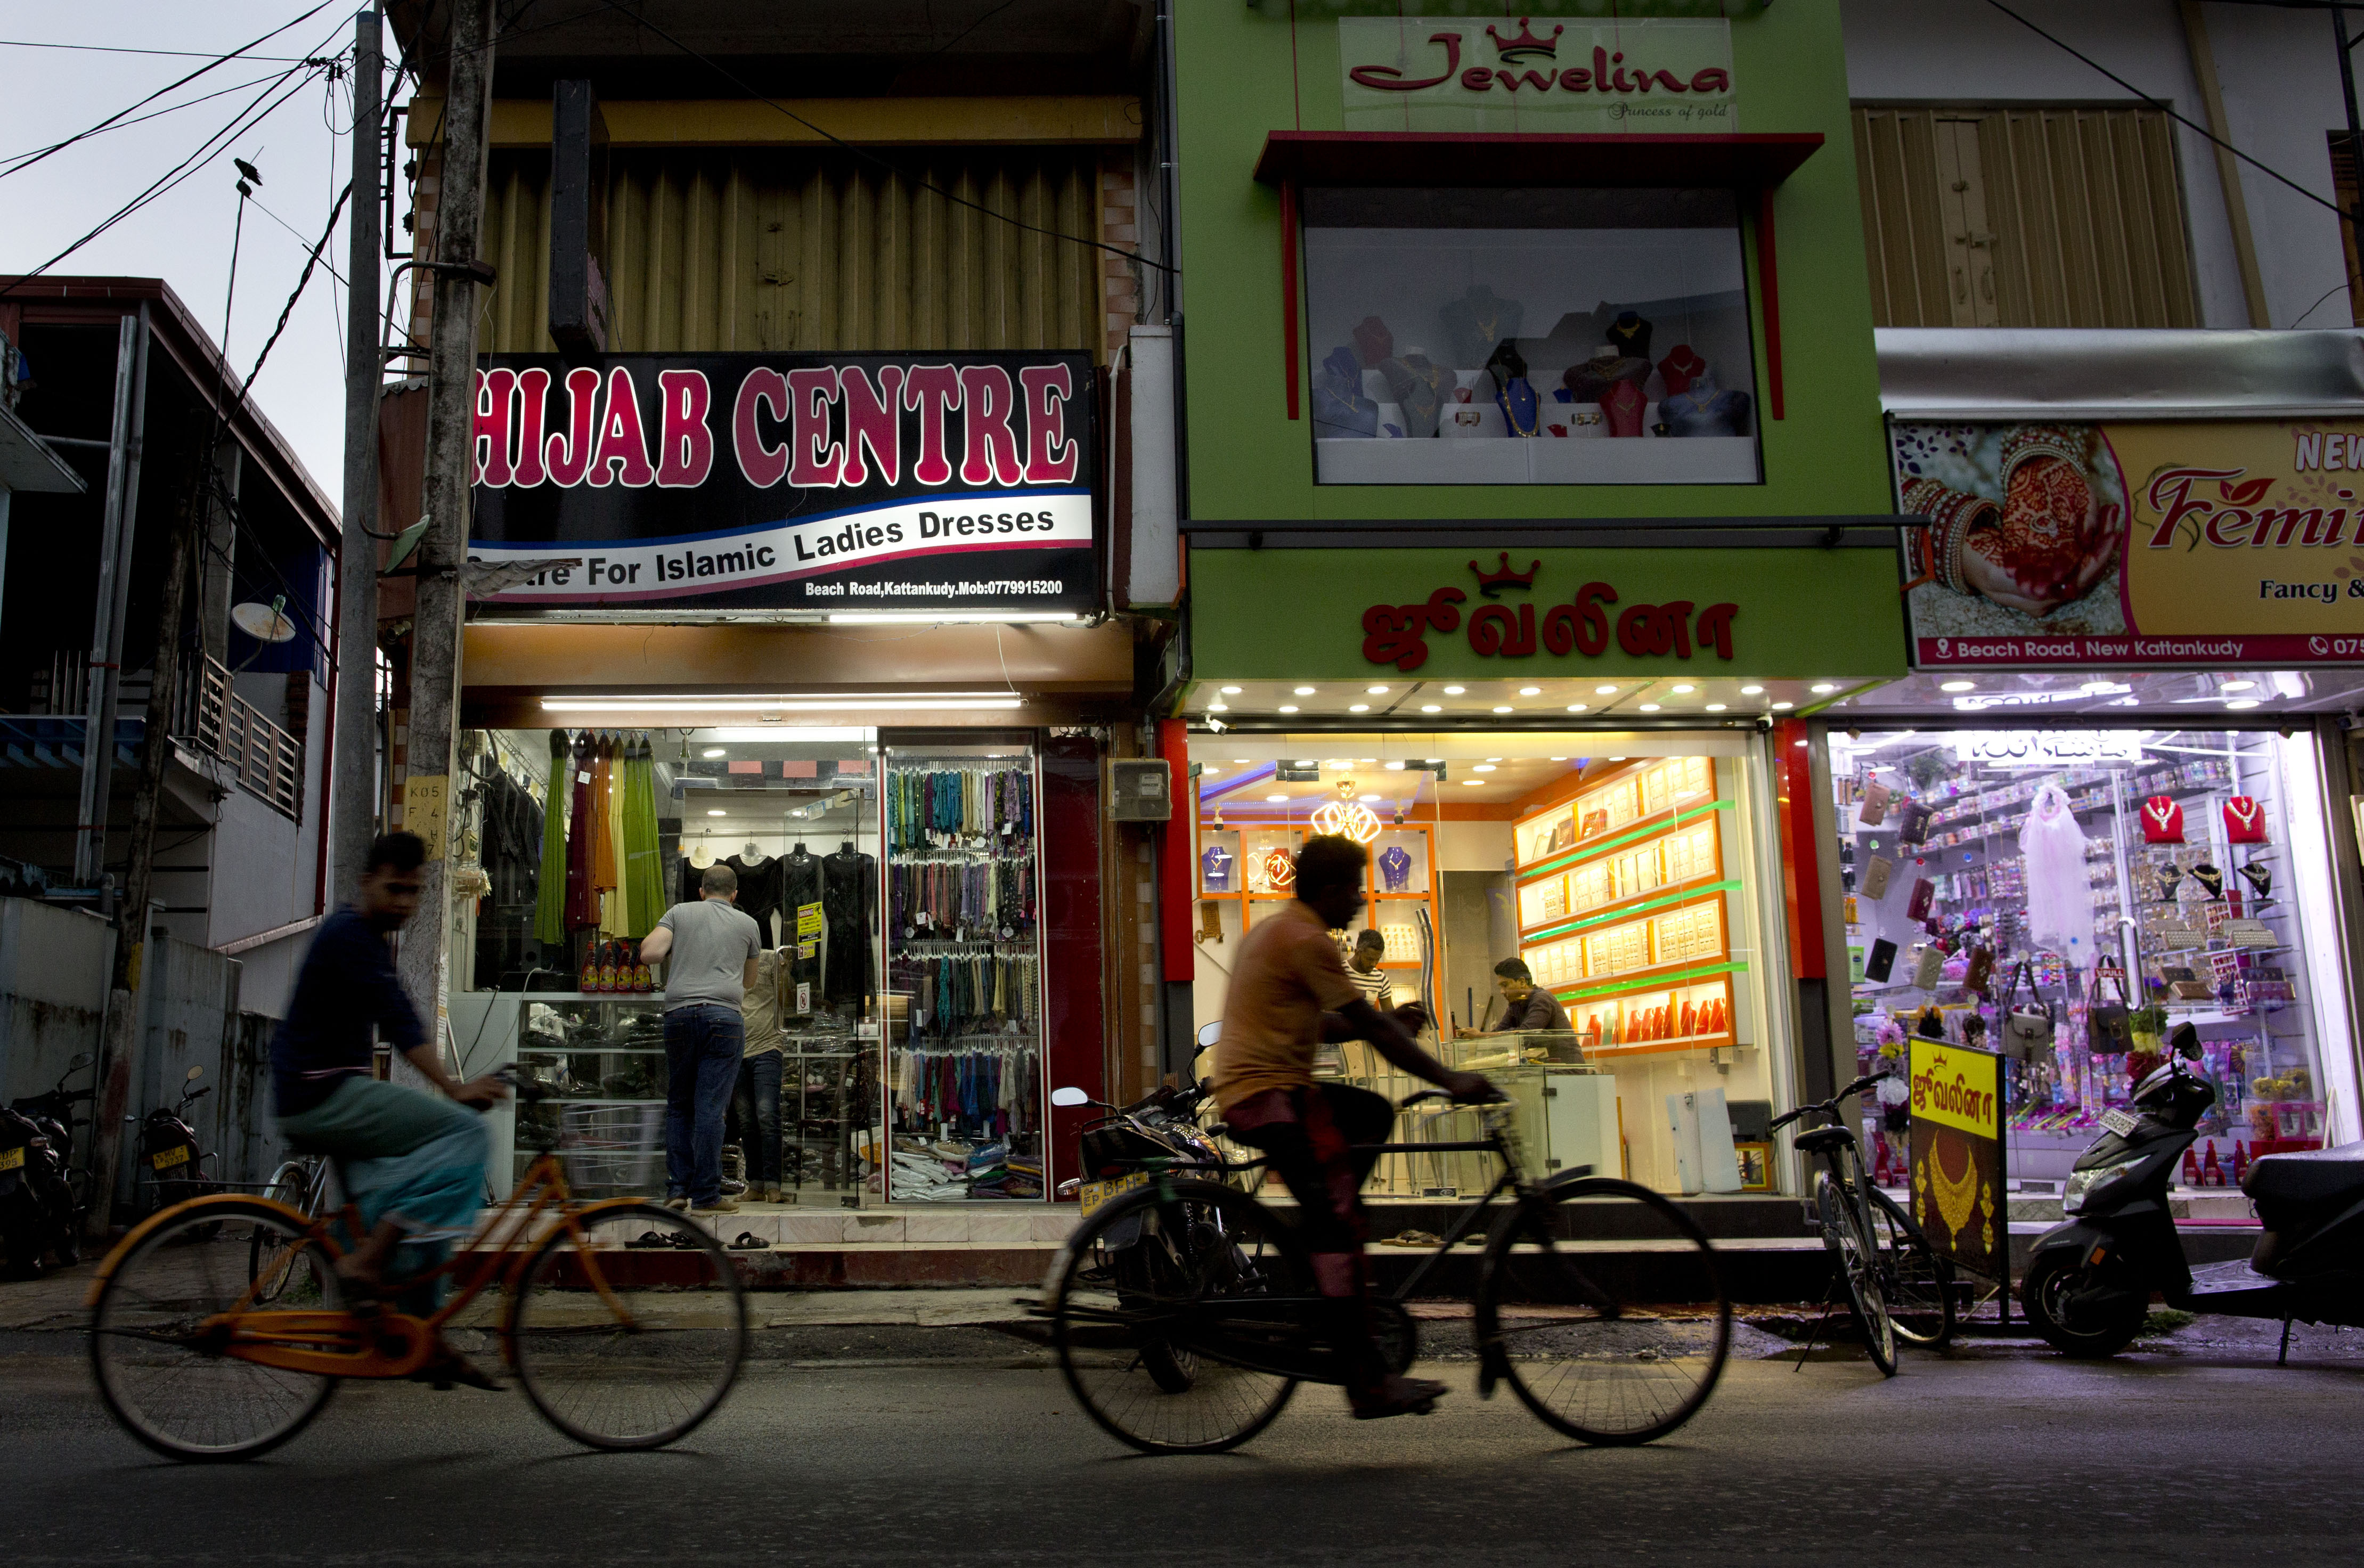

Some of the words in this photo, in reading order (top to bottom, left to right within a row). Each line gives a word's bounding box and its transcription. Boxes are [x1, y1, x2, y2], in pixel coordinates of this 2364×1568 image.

[1349, 33, 1730, 93] Jewelina
[1608, 101, 1672, 120] Princess
[1678, 104, 1692, 120] of
[1698, 103, 1727, 120] gold
[470, 366, 714, 488] HIJAB
[732, 363, 1079, 488] CENTRE
[2148, 467, 2364, 548] Femi
[589, 558, 641, 585] For
[656, 543, 776, 581] Islamic
[793, 518, 903, 561] Ladies
[919, 511, 1054, 539] Dresses
[806, 583, 844, 596] Beach
[2260, 579, 2338, 603] Fancy
[1958, 642, 2019, 658] Beach
[2025, 641, 2081, 659] Road,
[2086, 641, 2129, 656] New
[2134, 640, 2243, 659] Kattankudy
[800, 909, 813, 917] WARNING
[1083, 1194, 1099, 1207] EP
